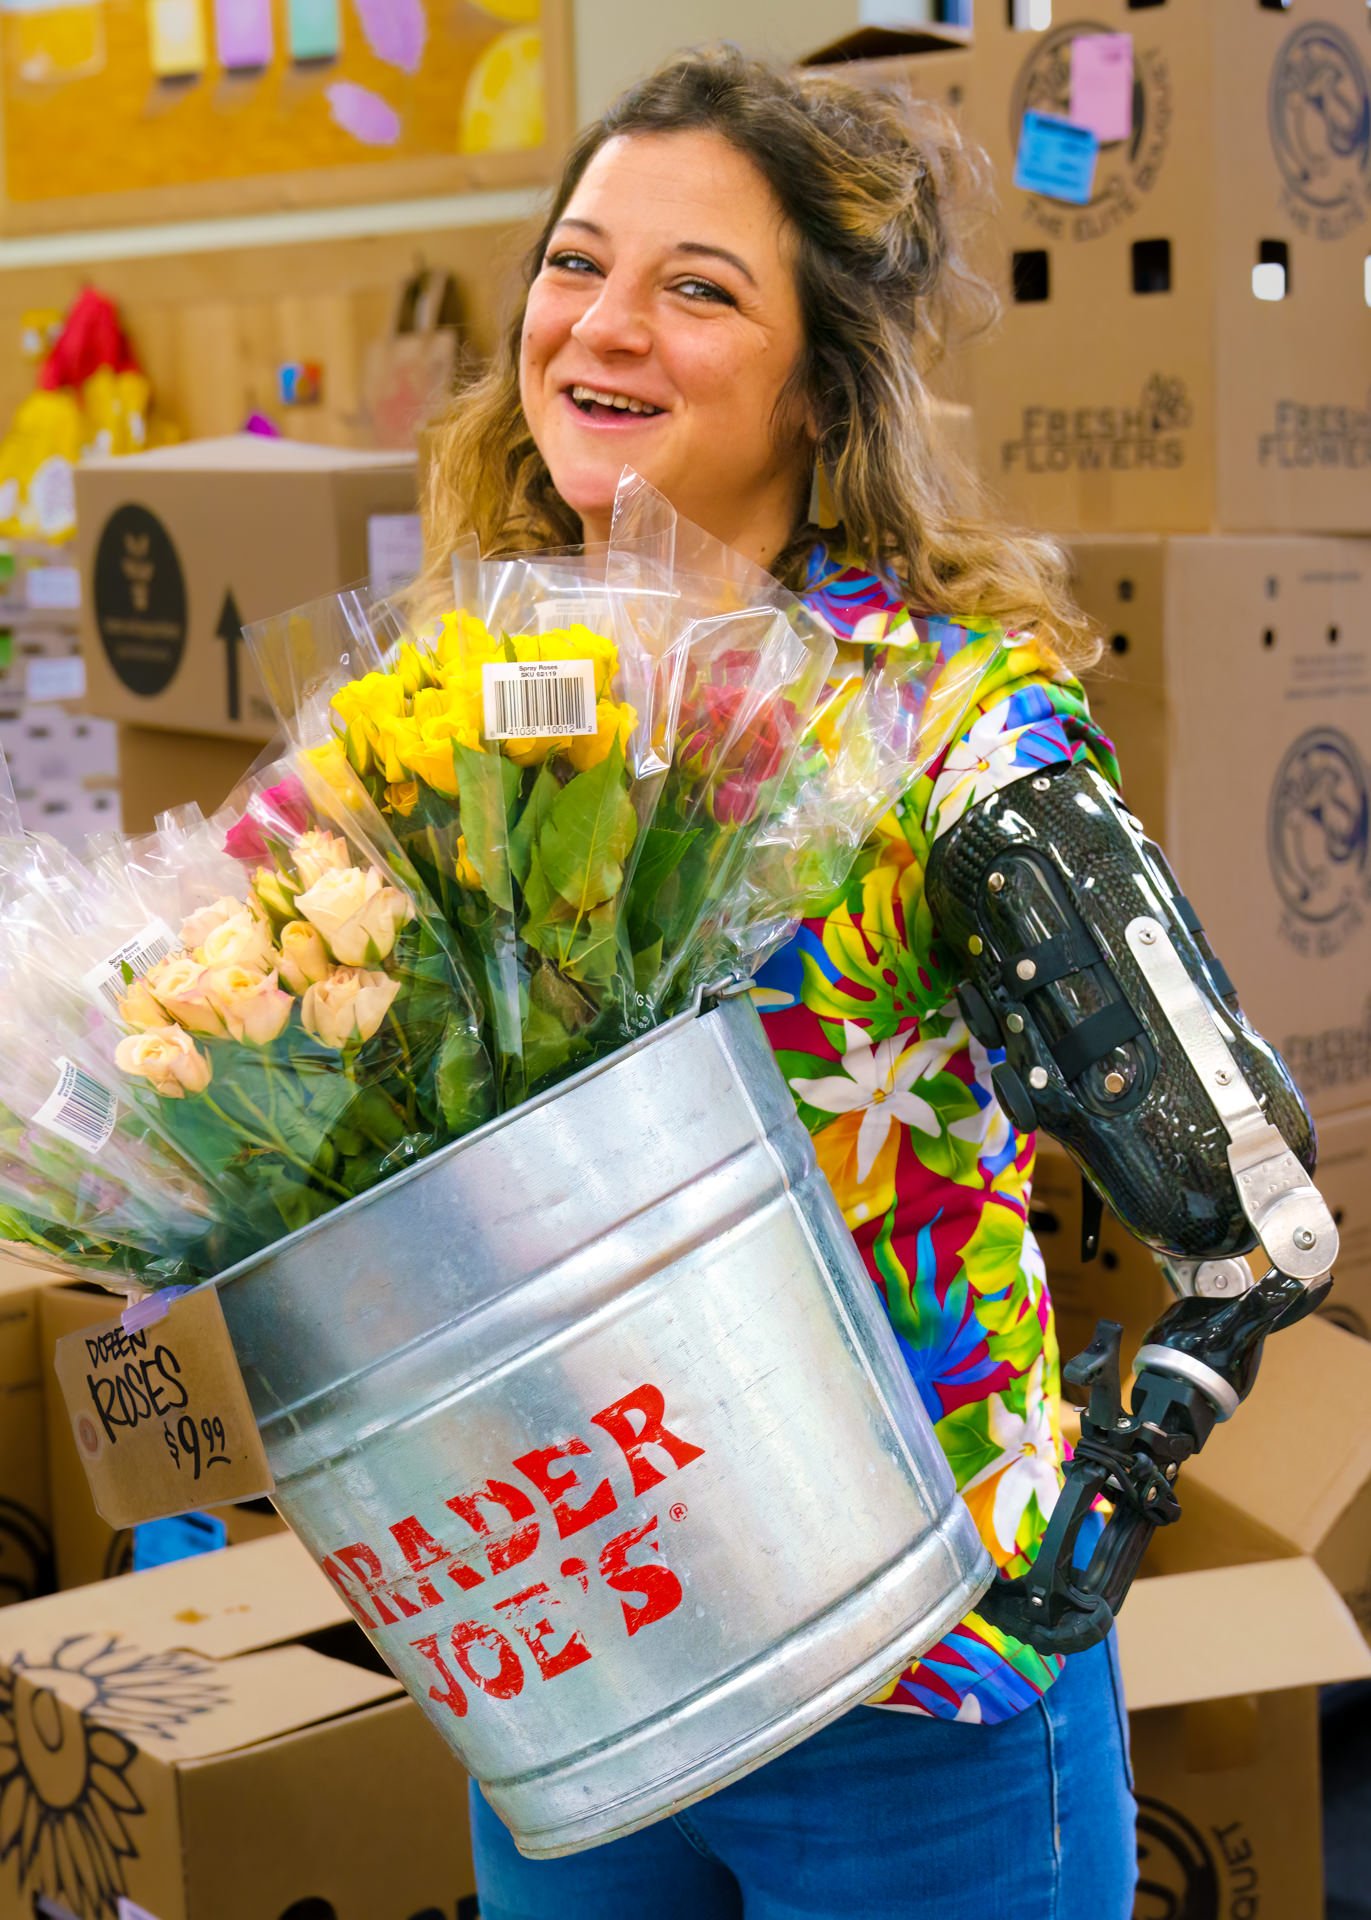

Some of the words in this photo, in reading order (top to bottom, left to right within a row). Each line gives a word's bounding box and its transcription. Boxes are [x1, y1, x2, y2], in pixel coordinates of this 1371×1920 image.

[1022, 405, 1143, 443] FRESH
[1001, 436, 1184, 474] FLOWERS
[508, 726, 537, 736] 41038
[546, 725, 575, 735] 10012
[86, 1344, 189, 1445] ROSES
[408, 1514, 684, 1718] JOE'S
